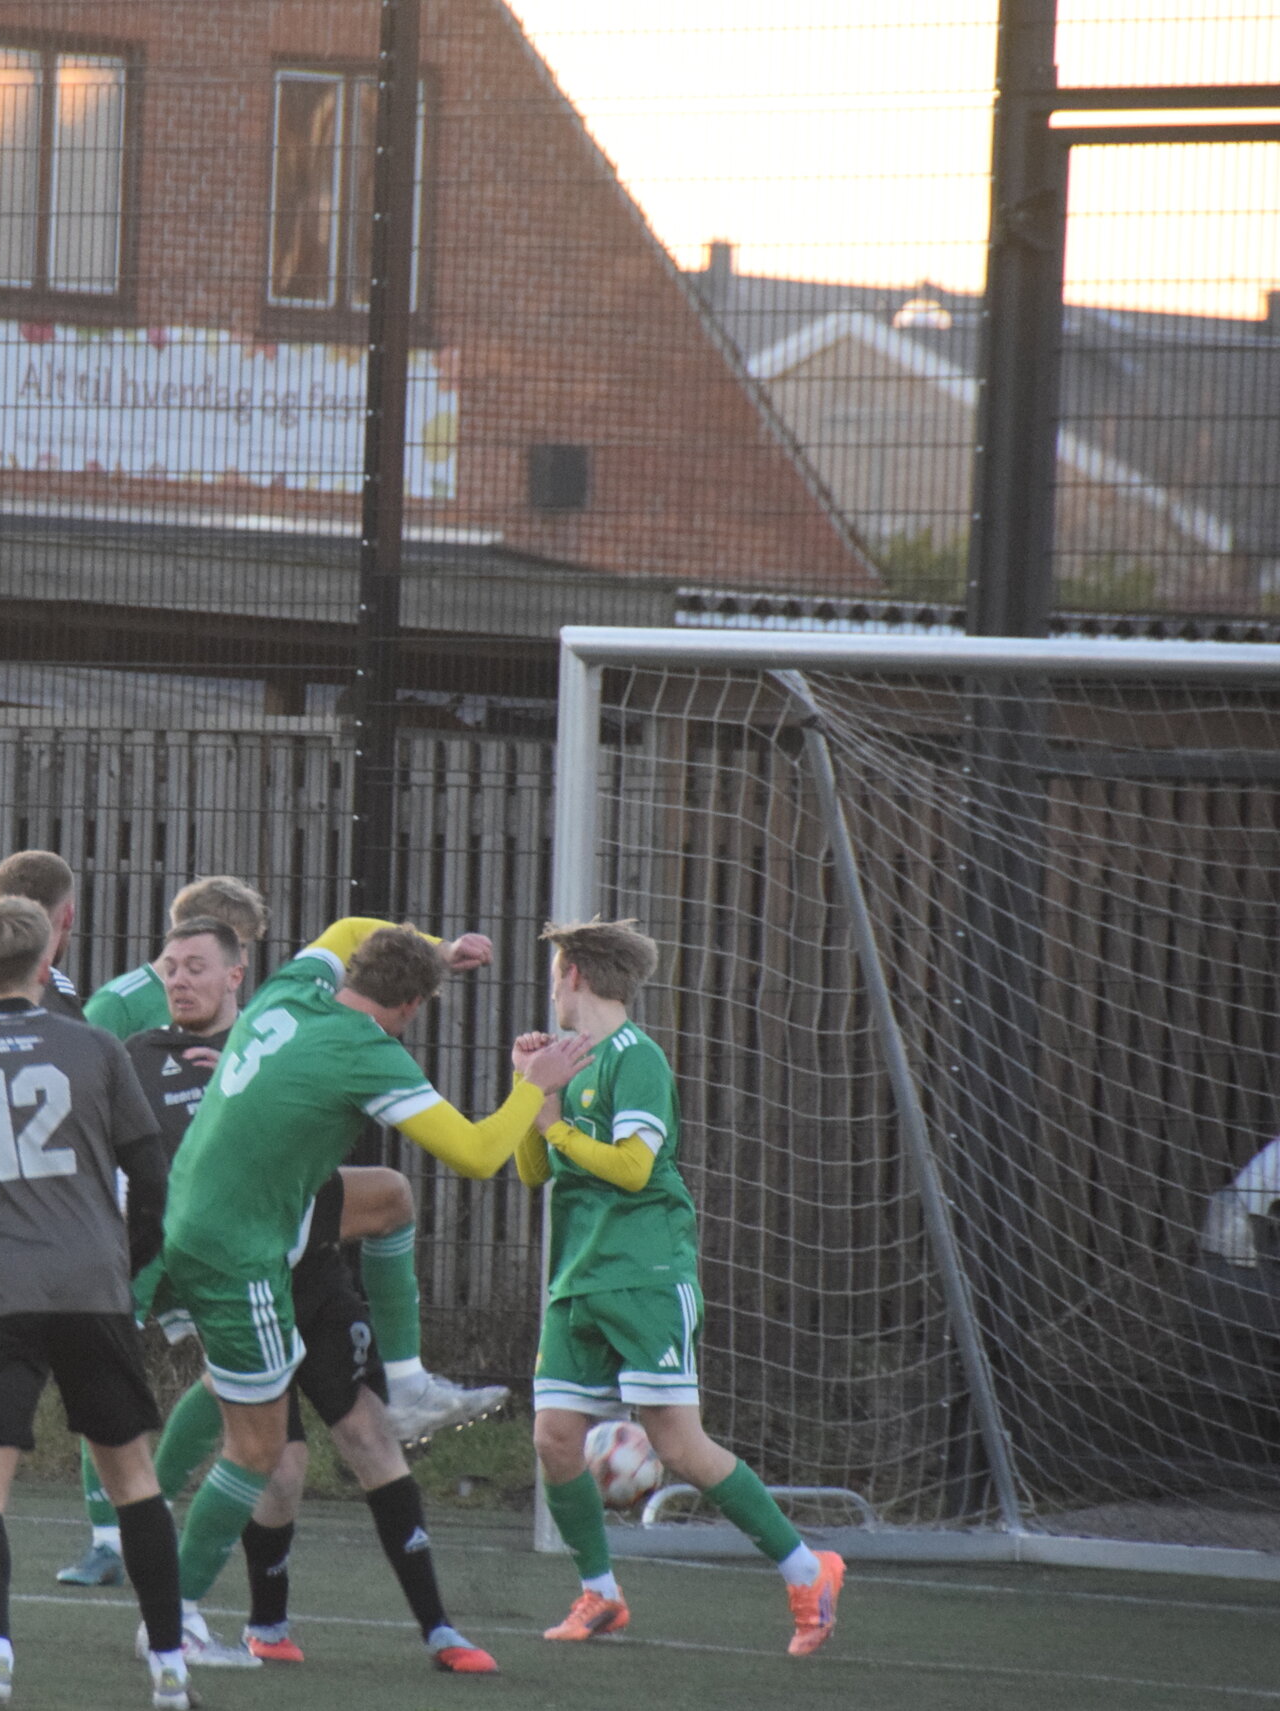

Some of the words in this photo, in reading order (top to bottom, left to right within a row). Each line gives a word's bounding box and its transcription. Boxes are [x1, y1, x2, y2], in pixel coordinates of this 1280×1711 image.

[19, 361, 67, 401] Alt
[75, 365, 112, 405] til
[119, 365, 253, 427] hverdag
[263, 390, 301, 430] og
[220, 1007, 299, 1098] 3
